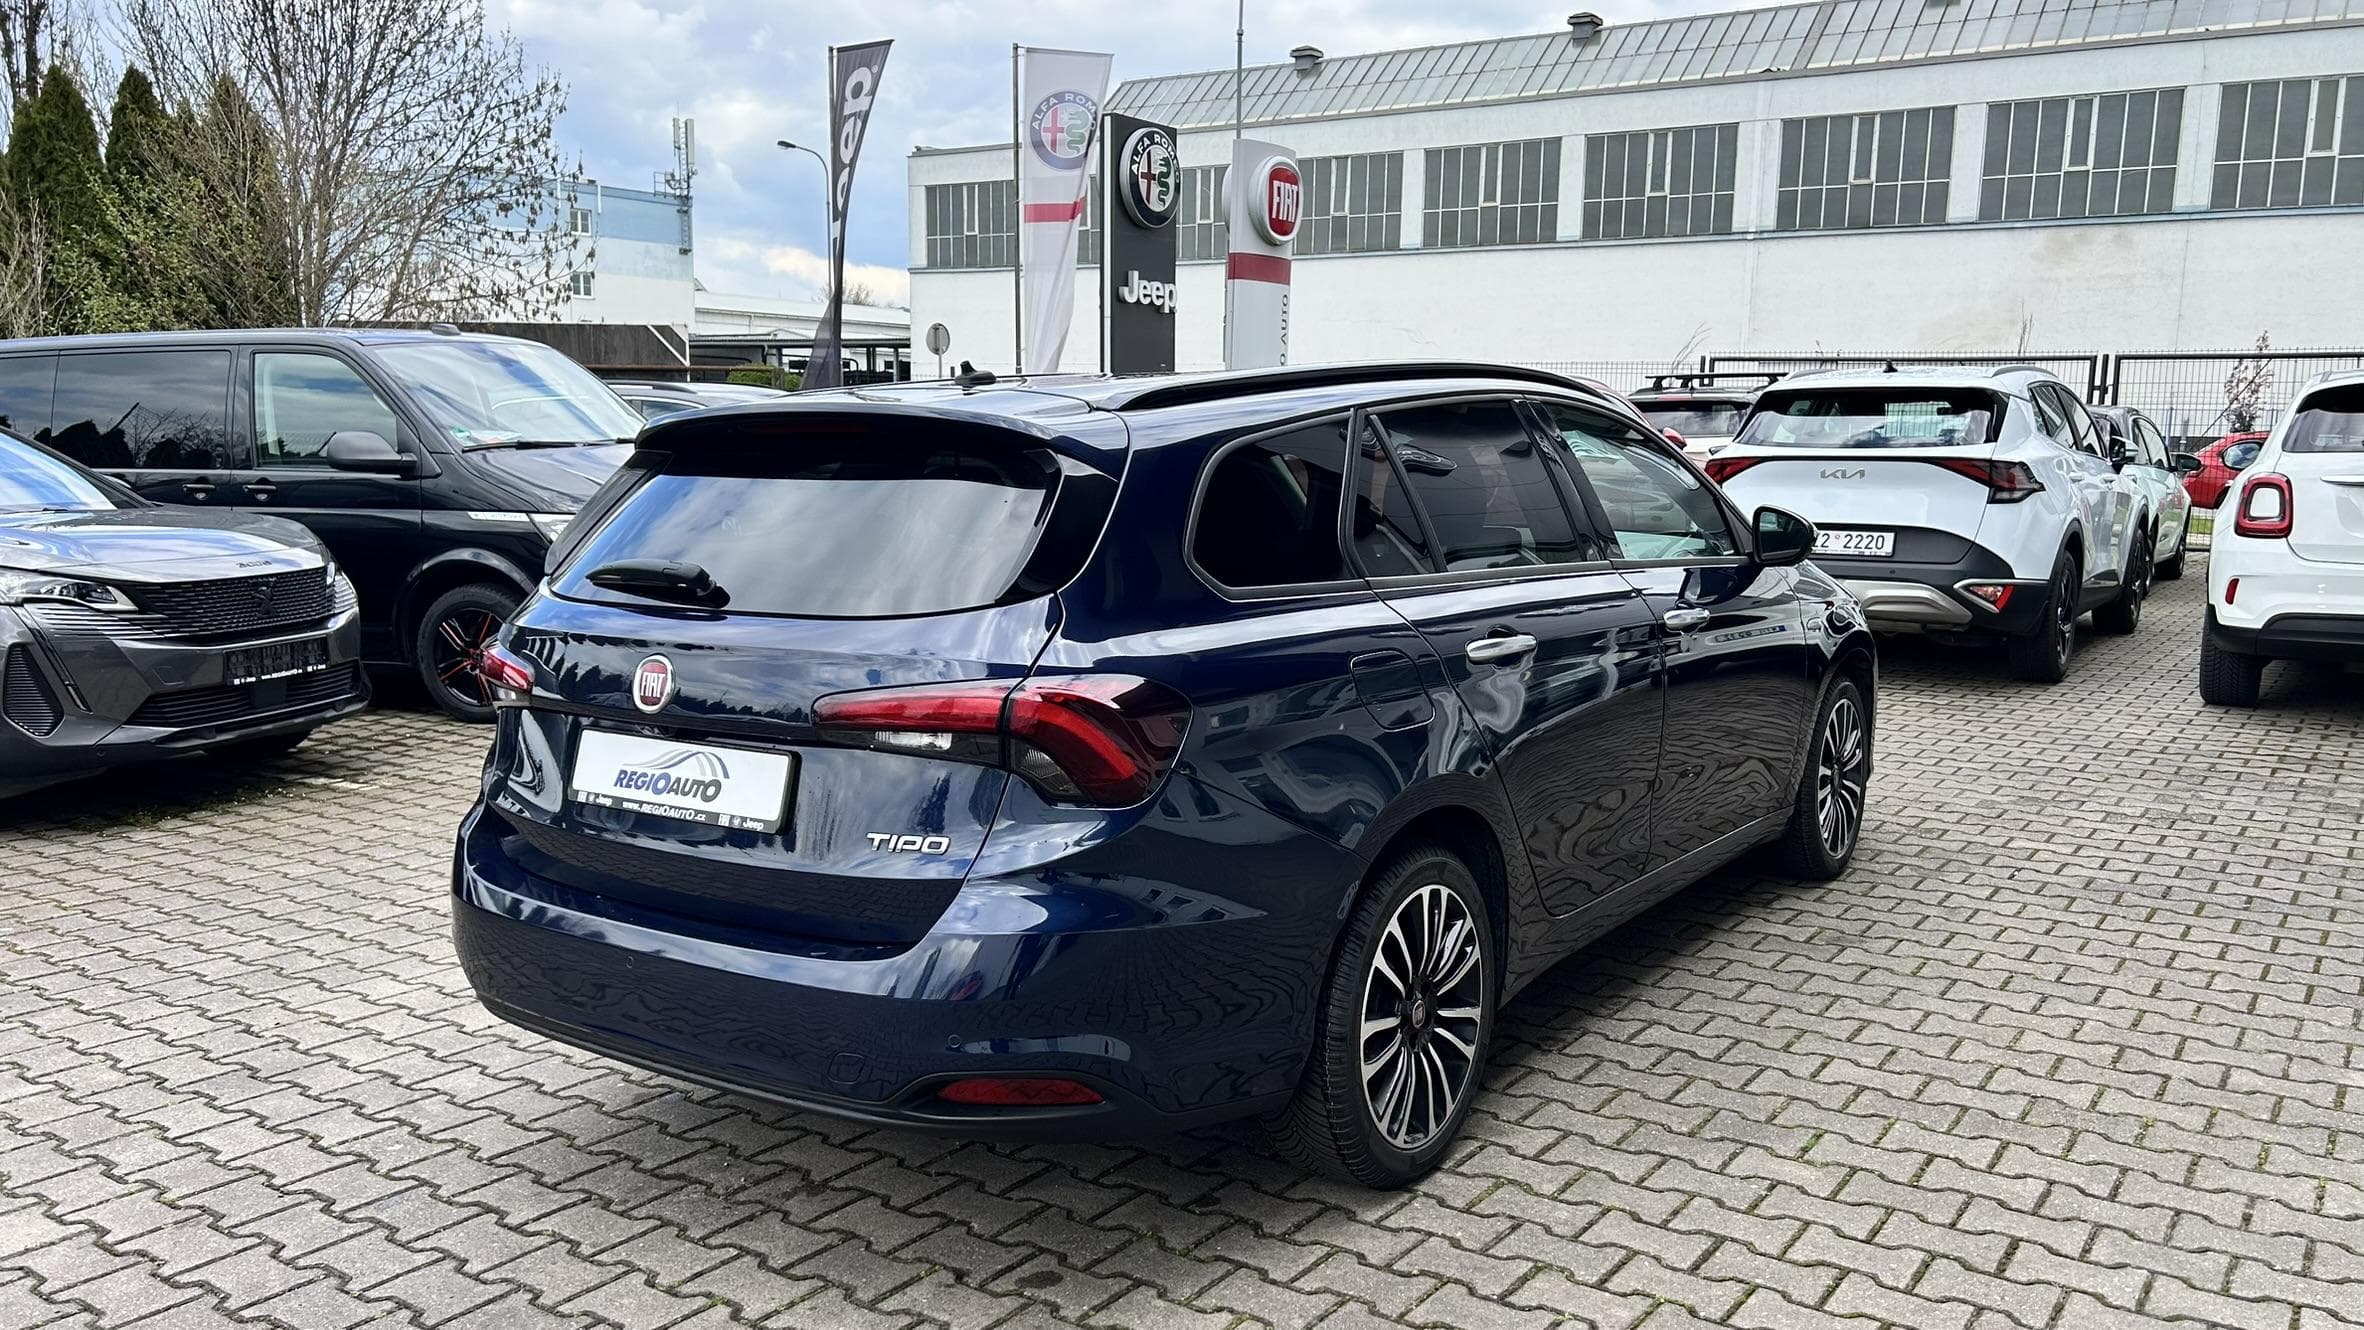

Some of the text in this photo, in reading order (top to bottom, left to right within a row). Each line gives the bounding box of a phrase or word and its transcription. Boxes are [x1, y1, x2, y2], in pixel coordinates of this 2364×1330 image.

[1032, 96, 1058, 130] ALFA
[1131, 137, 1150, 175] ALFA
[1271, 180, 1298, 223] FIAT
[1119, 270, 1177, 313] Jeep
[1280, 294, 1288, 345] AUTO
[1843, 534, 1885, 549] 2220
[640, 671, 666, 697] FIAT
[613, 769, 722, 803] REGIOAUTO
[866, 832, 951, 855] TIPO
